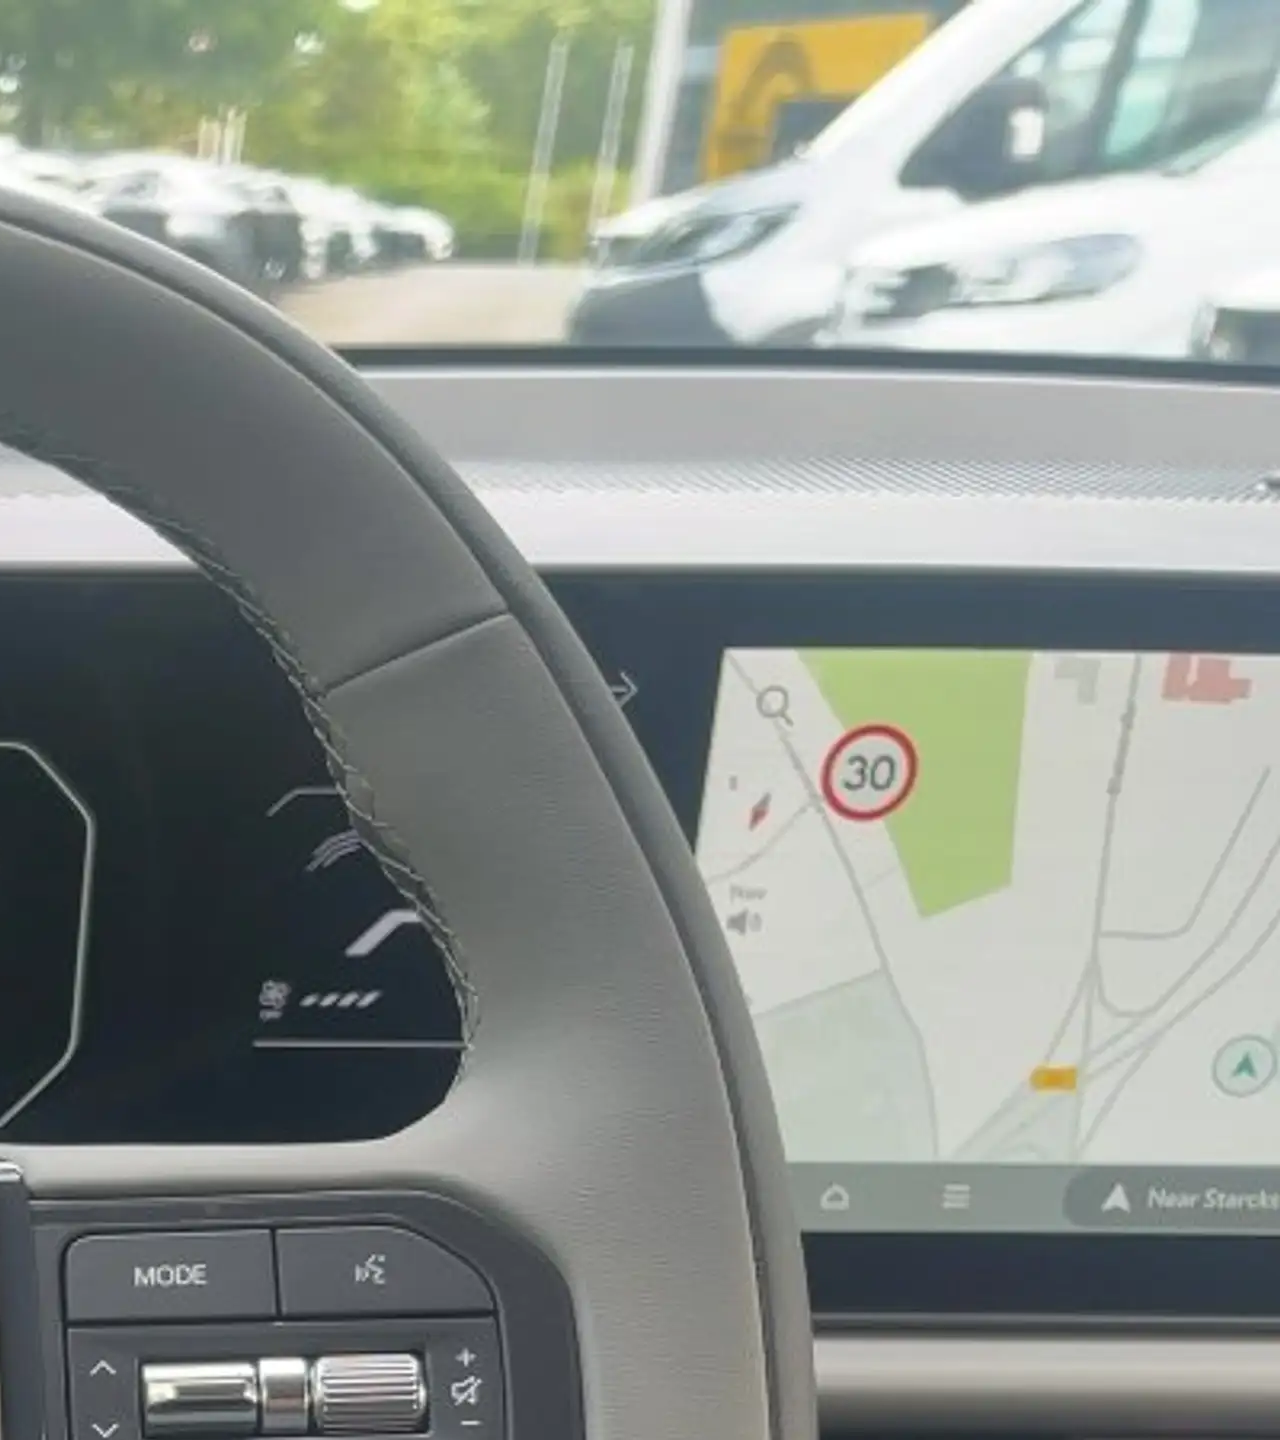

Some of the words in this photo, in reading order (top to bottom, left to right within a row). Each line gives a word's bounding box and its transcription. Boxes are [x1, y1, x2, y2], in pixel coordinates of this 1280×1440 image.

[844, 756, 896, 791] 30
[1147, 1186, 1200, 1209] Near
[133, 1264, 208, 1286] MODE
